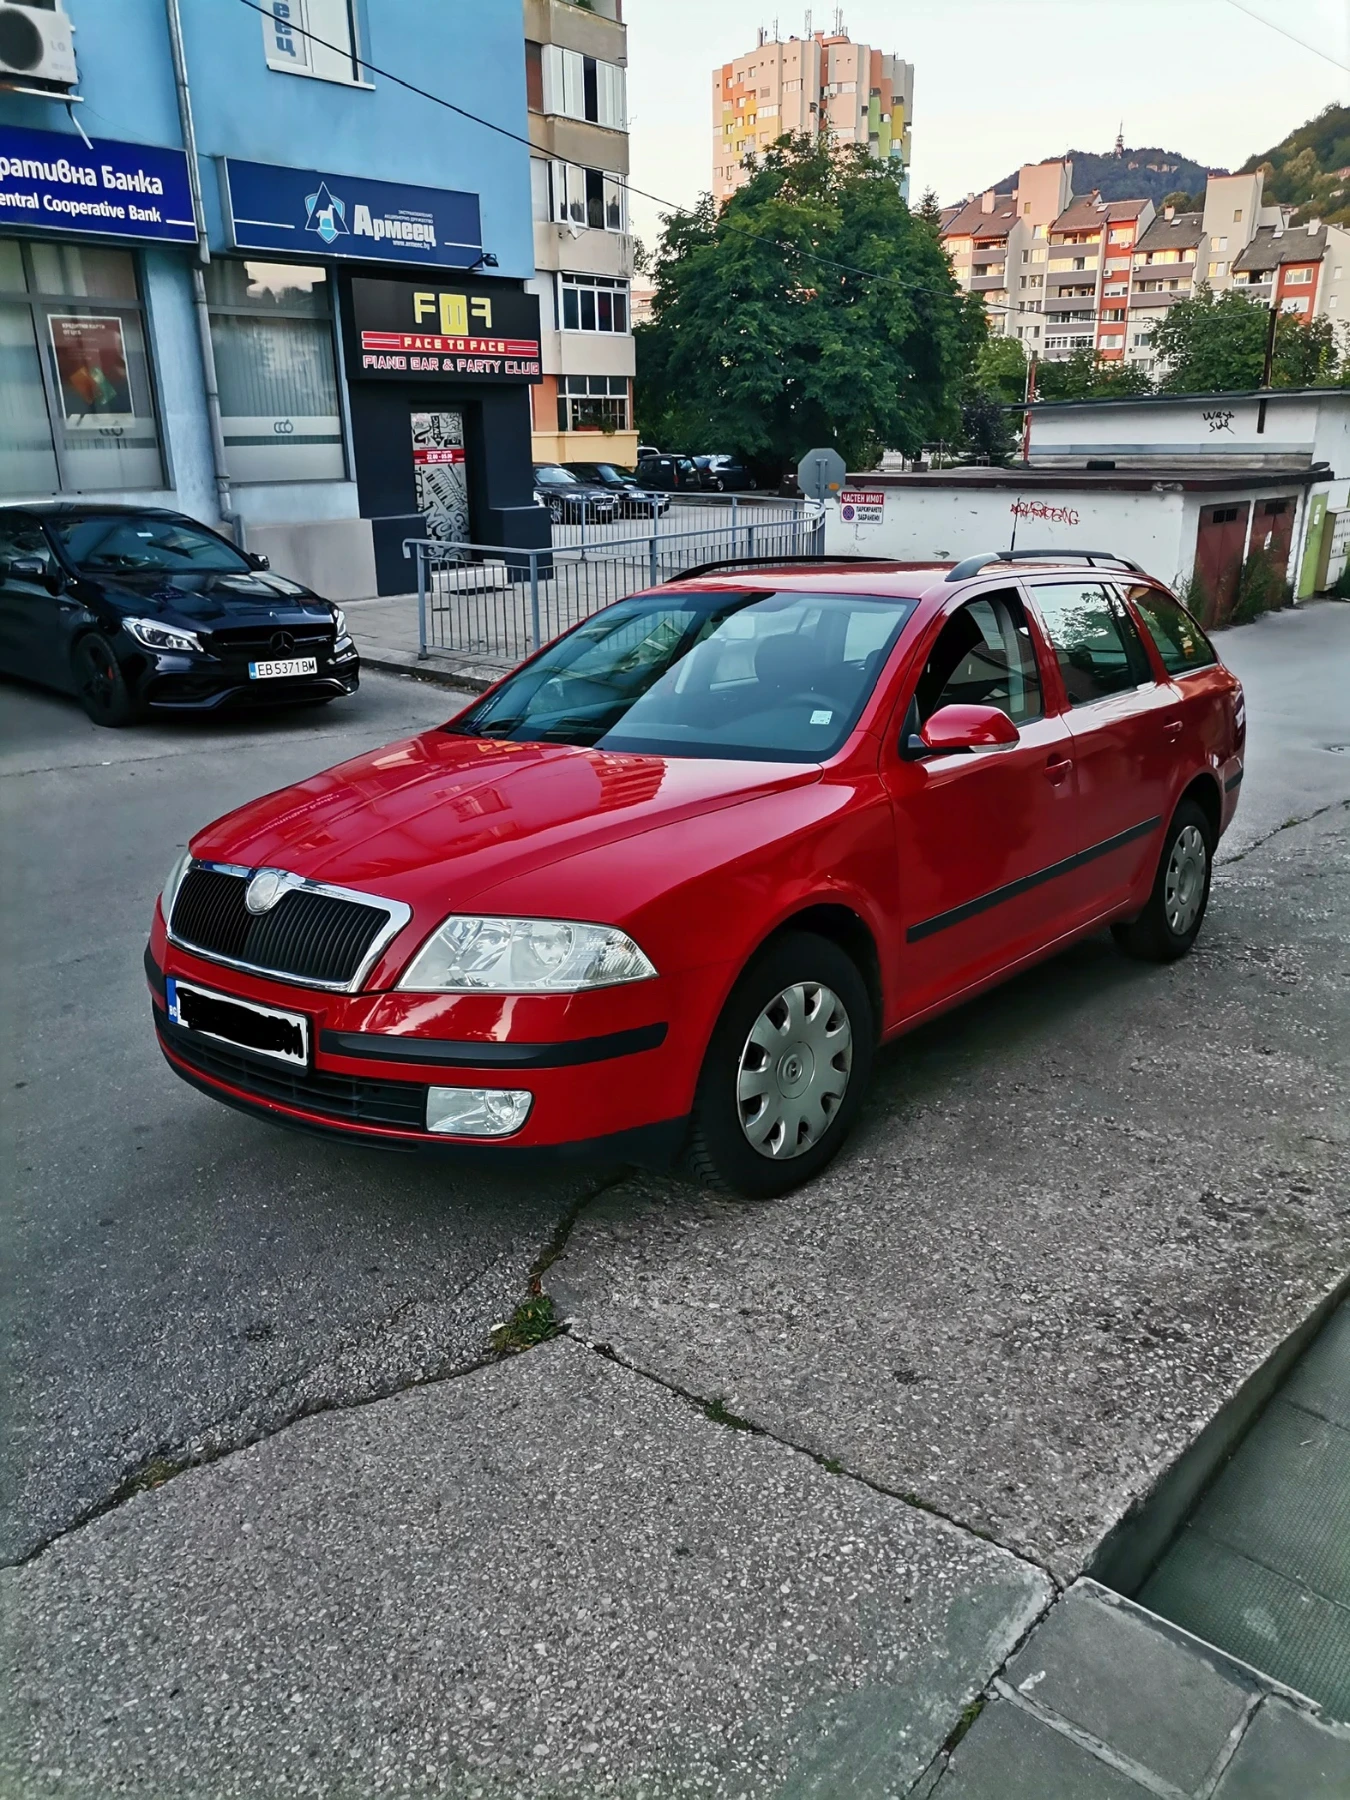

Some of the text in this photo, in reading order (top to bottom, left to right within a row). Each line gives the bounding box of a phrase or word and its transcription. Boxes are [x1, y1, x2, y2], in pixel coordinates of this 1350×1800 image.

[101, 165, 163, 195] Банка
[43, 194, 125, 219] Cooperative
[128, 205, 161, 222] Bank
[353, 204, 436, 247] Армеец
[404, 337, 505, 352] FACE TO FACE
[362, 354, 539, 375] PIANO BAR & PARTY CLUB
[842, 493, 882, 504] ЧАСТЕН ИМОТ
[257, 660, 315, 676] EB 5371 BM
[168, 1004, 177, 1017] BG
